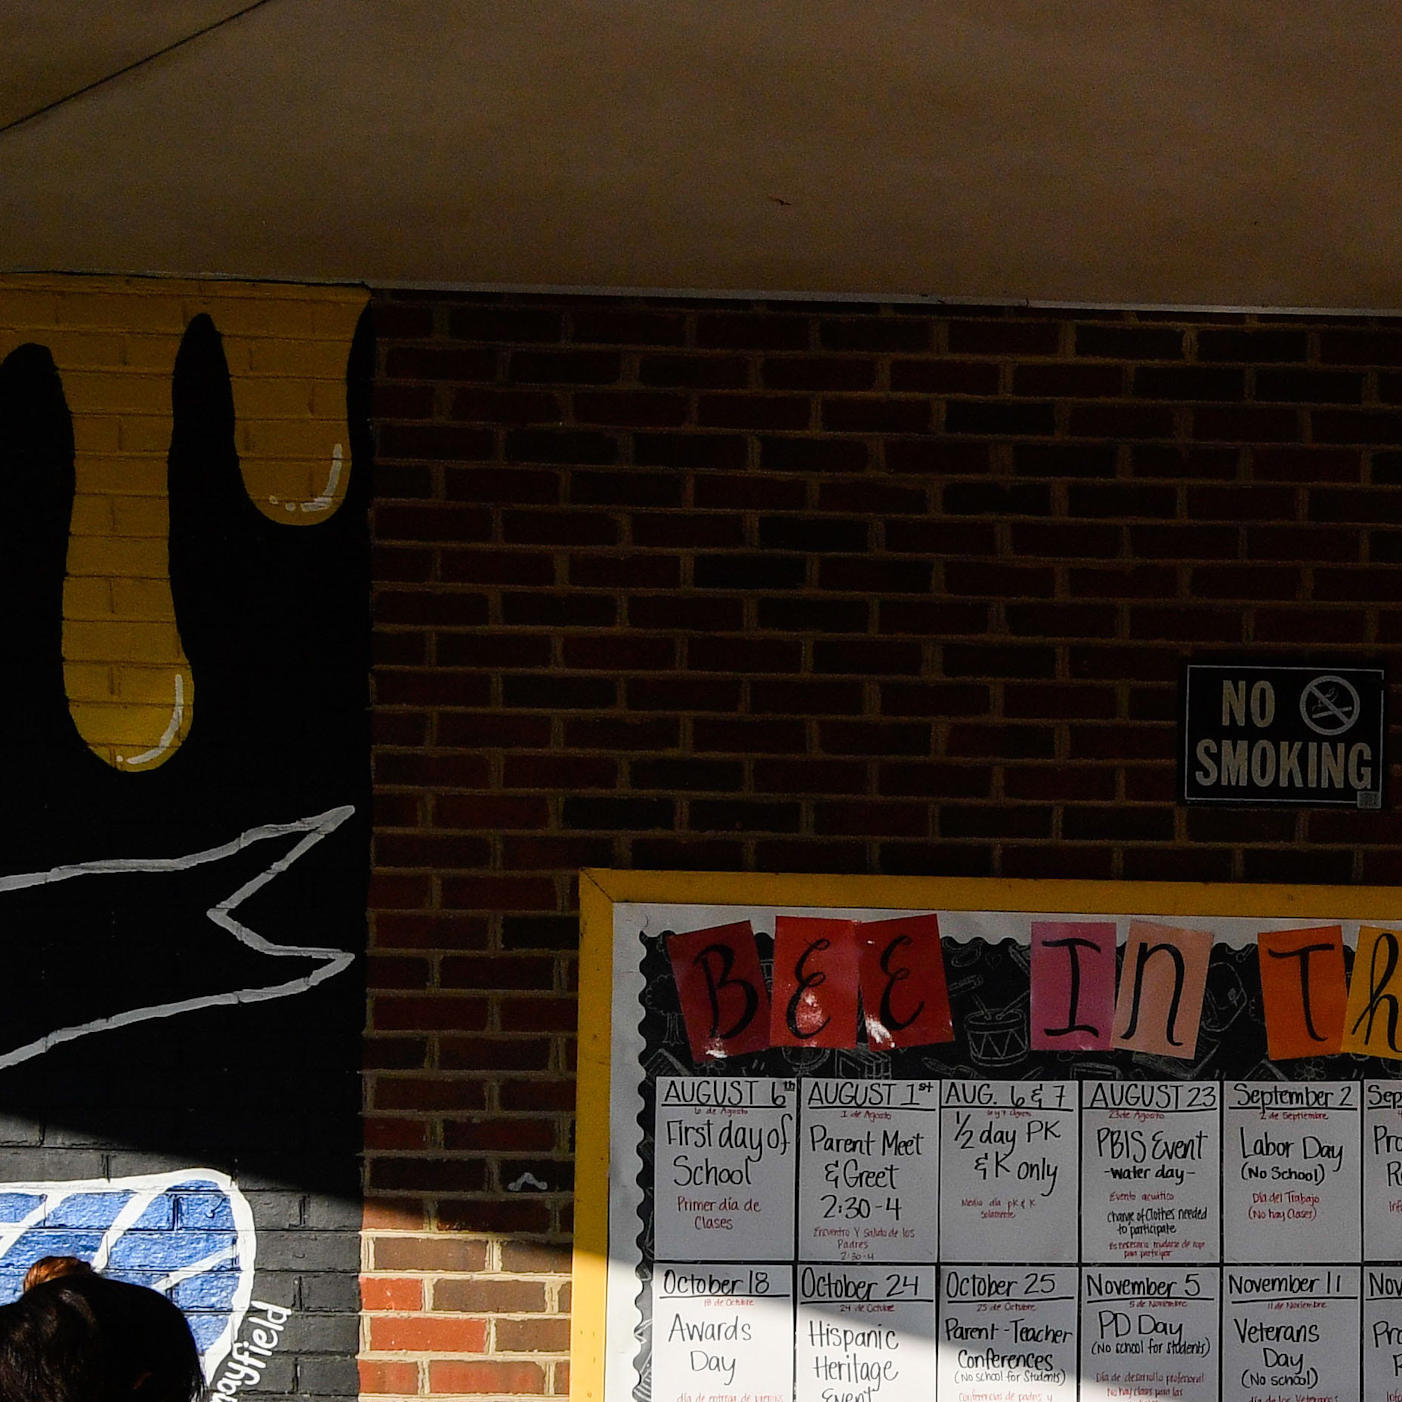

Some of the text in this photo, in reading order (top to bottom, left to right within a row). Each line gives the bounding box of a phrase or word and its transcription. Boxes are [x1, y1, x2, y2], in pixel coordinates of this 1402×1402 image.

[1221, 679, 1276, 728] NO
[1195, 738, 1372, 790] SMOKING
[664, 1081, 758, 1105] AUGUST
[808, 1081, 934, 1106] AUGUST 1st
[945, 1082, 1066, 1108] AUG. 6 & 7
[1090, 1083, 1217, 1109] AUGUST 23
[1233, 1083, 1353, 1113] September 2
[666, 1114, 793, 1162] First day of
[810, 1125, 924, 1156] Parent Meet
[979, 1121, 1017, 1159] day
[1027, 1119, 1061, 1143] PK
[1097, 1127, 1209, 1163] PBIS Event
[1239, 1126, 1344, 1173] Labor Day
[673, 1155, 752, 1186] School
[825, 1159, 899, 1190] & Greet
[974, 1151, 1058, 1197] & K only
[1241, 1162, 1325, 1185] (No School)
[1117, 1222, 1177, 1237] to participate
[663, 1269, 770, 1294] October 18
[801, 1267, 919, 1300] October 24
[946, 1271, 1056, 1298] October 25
[1086, 1273, 1201, 1297] November 5
[1229, 1271, 1341, 1294] November 11
[668, 1313, 752, 1343] Awards
[808, 1319, 899, 1352] Hispanic
[1098, 1310, 1184, 1349] PD Day
[1233, 1318, 1320, 1344] Veterans
[957, 1350, 1053, 1371] Conferences
[1091, 1338, 1112, 1355] (No
[1115, 1339, 1145, 1355] school
[1147, 1338, 1165, 1354] for
[1262, 1348, 1304, 1374] Day
[690, 1350, 736, 1386] Day
[812, 1352, 899, 1392] Heritage
[1241, 1367, 1319, 1389] (No school)
